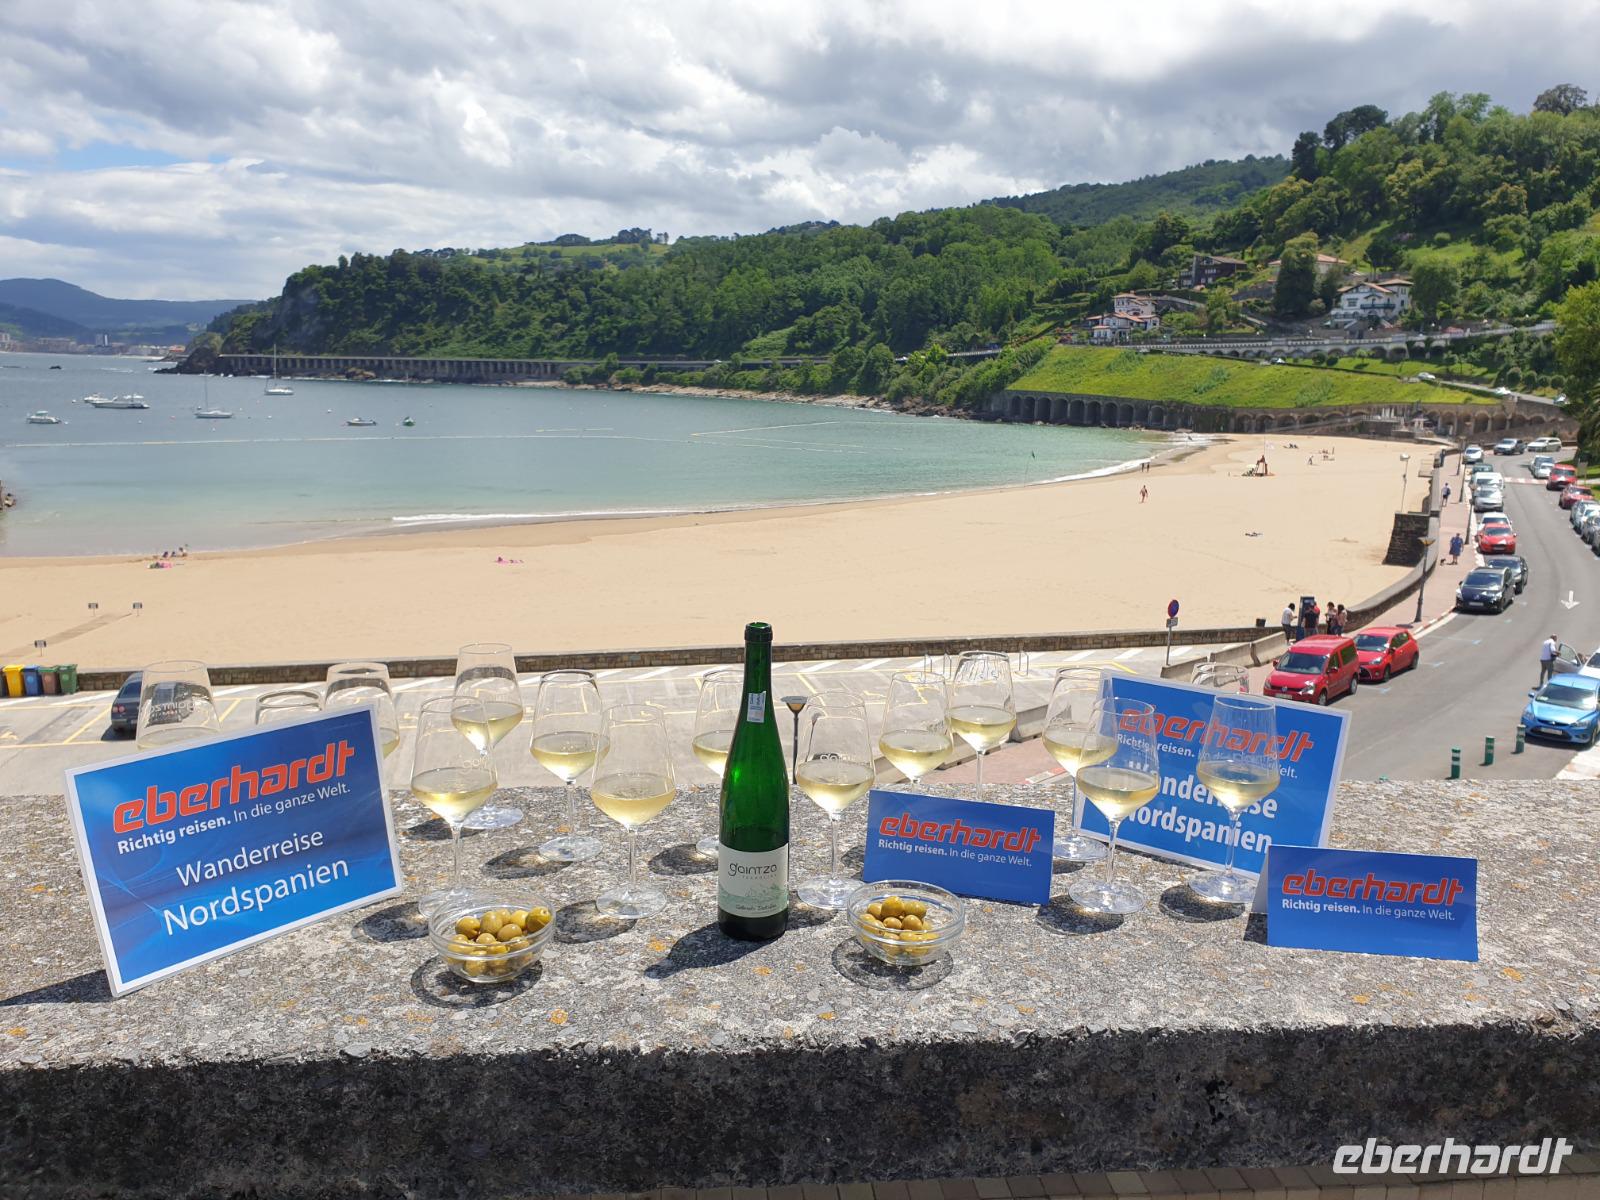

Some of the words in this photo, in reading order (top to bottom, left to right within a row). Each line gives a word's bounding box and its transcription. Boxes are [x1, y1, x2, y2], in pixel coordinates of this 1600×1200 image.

[1119, 704, 1313, 762] eberhardt
[1156, 742, 1196, 759] reisen.
[1279, 764, 1298, 779] elt.
[113, 739, 355, 833] eberhardt
[117, 828, 177, 855] Richtig
[179, 815, 231, 838] reisen.
[233, 810, 248, 822] In
[250, 803, 273, 819] die
[275, 792, 316, 814] ganze
[317, 782, 351, 803] Welt.
[879, 812, 1041, 853] eberhardt
[176, 830, 324, 887] Wanderreise
[878, 839, 912, 854] Richtig
[914, 844, 948, 856] reisen.
[949, 848, 959, 857] In
[960, 848, 976, 860] die
[977, 854, 1007, 864] ganze
[1008, 855, 1033, 867] Welt.
[163, 859, 349, 936] Nordspanien
[1282, 869, 1464, 906] eberhardt
[1282, 899, 1321, 913] Richtig
[1323, 903, 1360, 914] reisen.
[1362, 905, 1373, 914] In
[1375, 905, 1392, 916] die
[1393, 909, 1426, 919] ganze
[1428, 909, 1456, 921] Welt.
